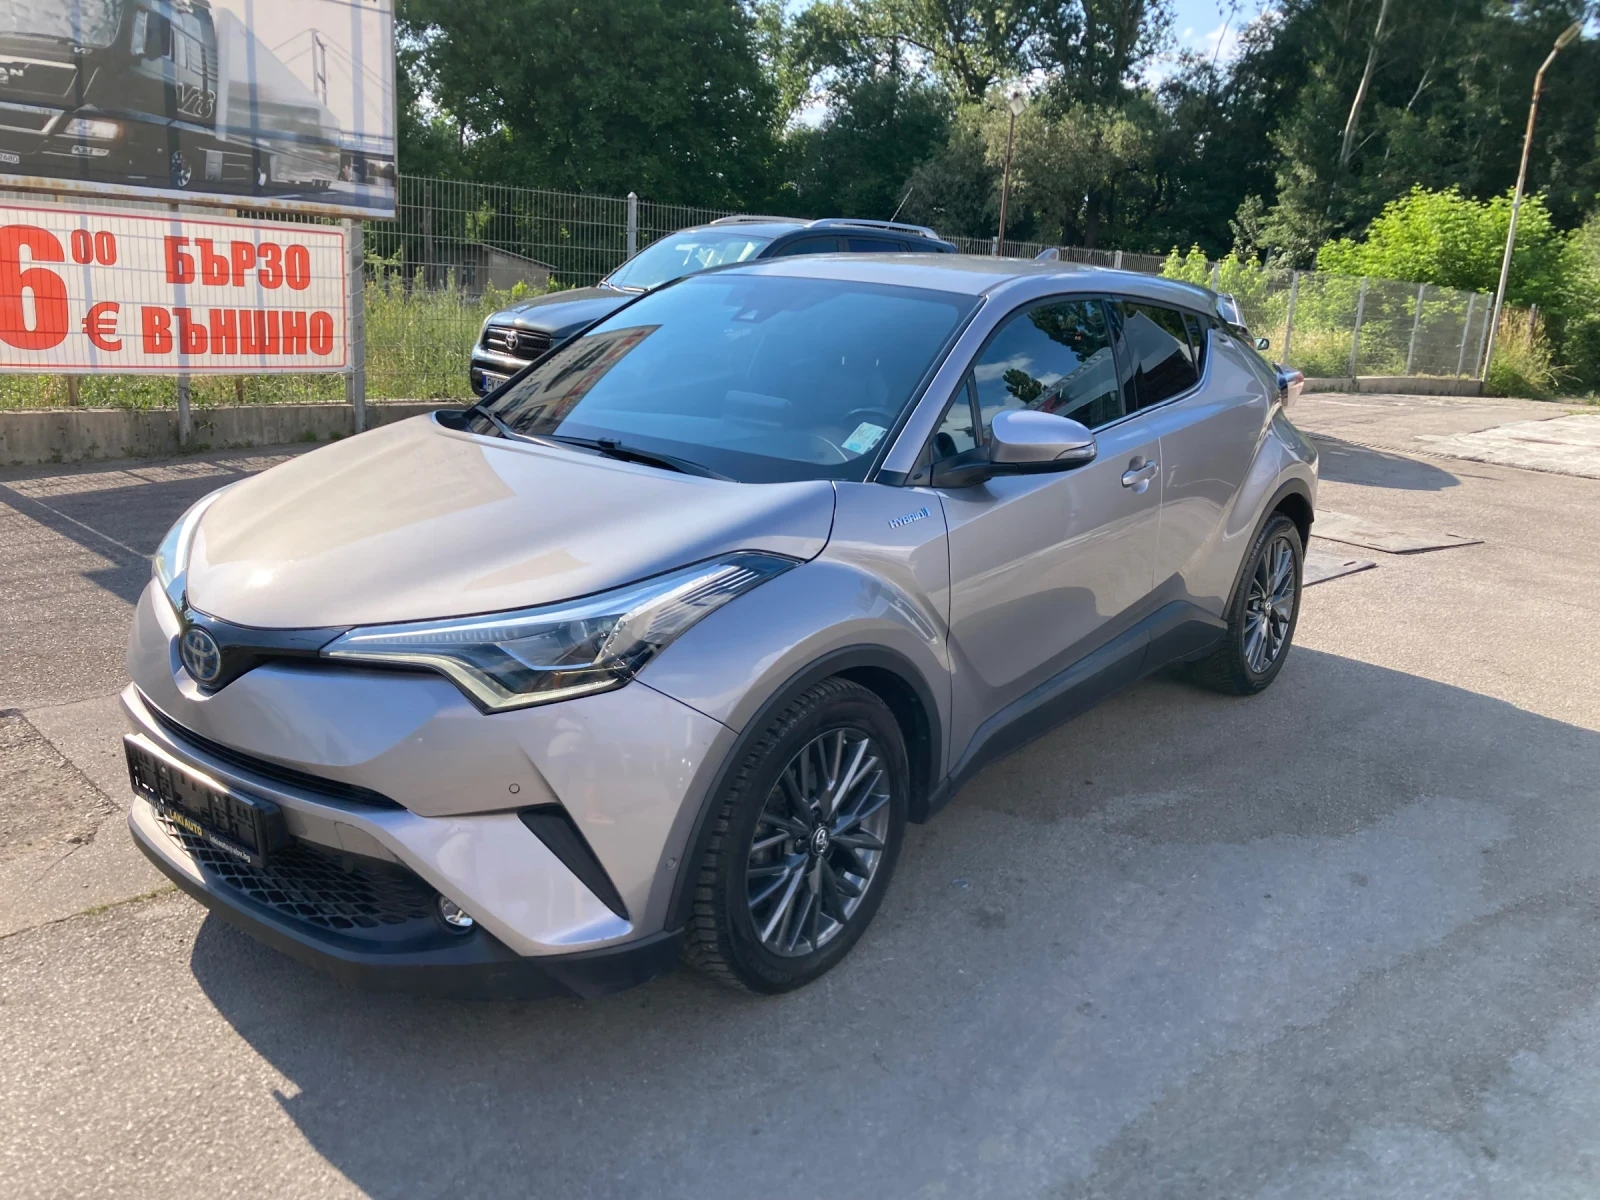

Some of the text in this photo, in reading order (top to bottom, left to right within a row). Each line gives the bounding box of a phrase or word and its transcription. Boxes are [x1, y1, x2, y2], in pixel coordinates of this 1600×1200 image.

[164, 235, 311, 291] БЪРЗО
[82, 301, 123, 352] €
[141, 306, 334, 356] ВЪНШНО
[888, 507, 931, 529] HYBRID
[184, 818, 203, 837] AUTO
